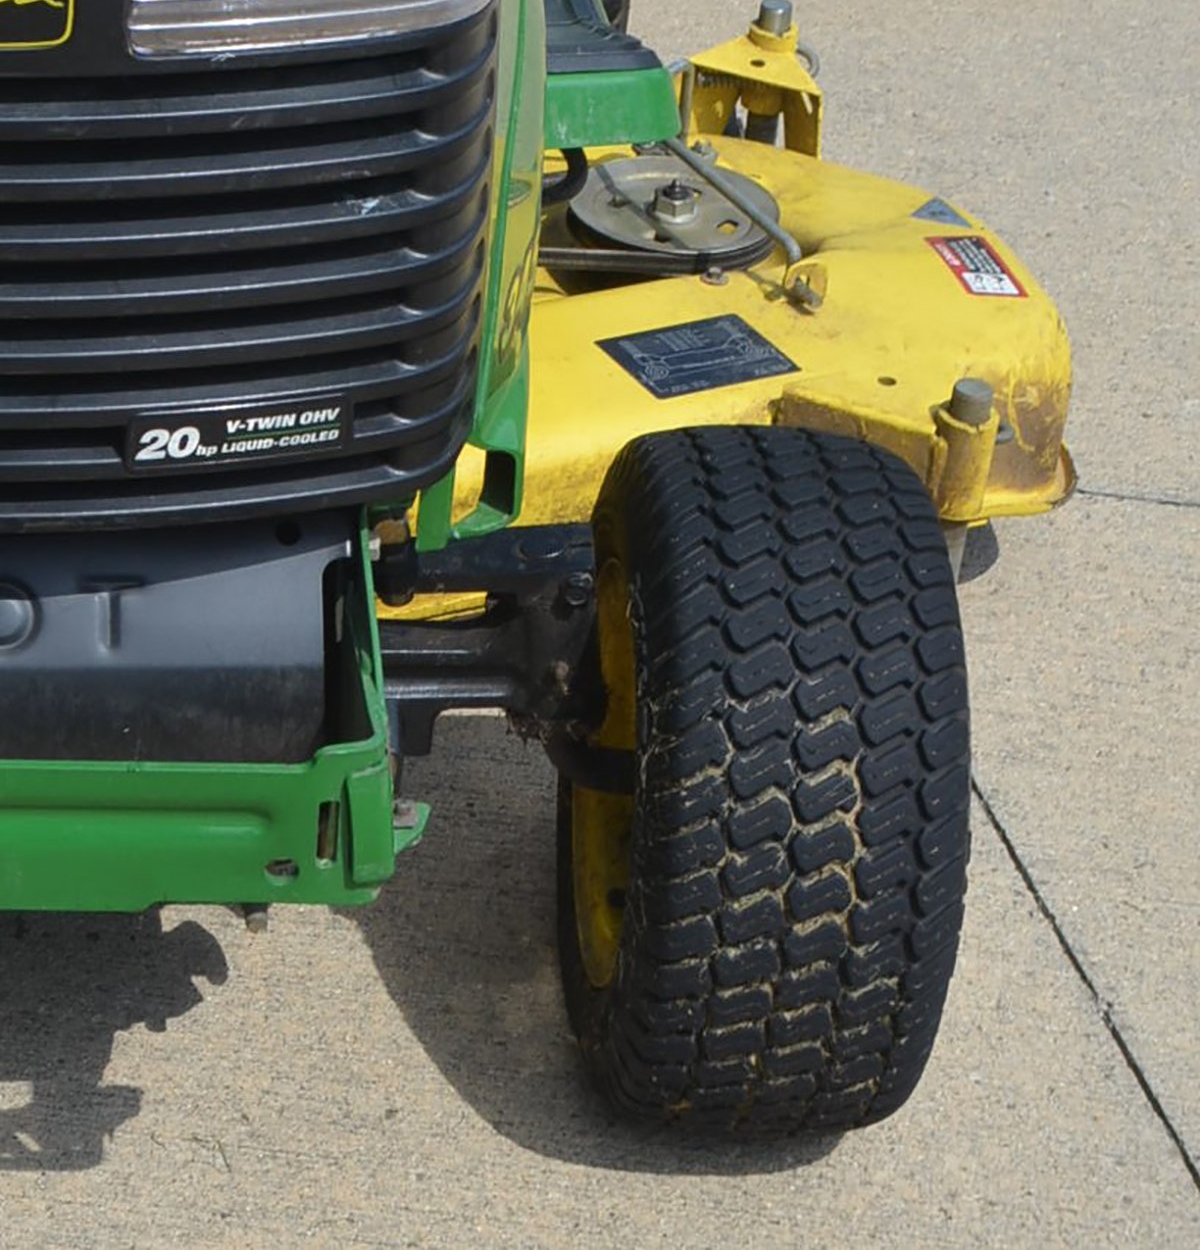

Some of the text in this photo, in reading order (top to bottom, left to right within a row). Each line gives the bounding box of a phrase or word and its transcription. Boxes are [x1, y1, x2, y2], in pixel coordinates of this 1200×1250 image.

[226, 408, 340, 434] V-TWIN OHV
[221, 429, 339, 454] LIQUID-COOLED
